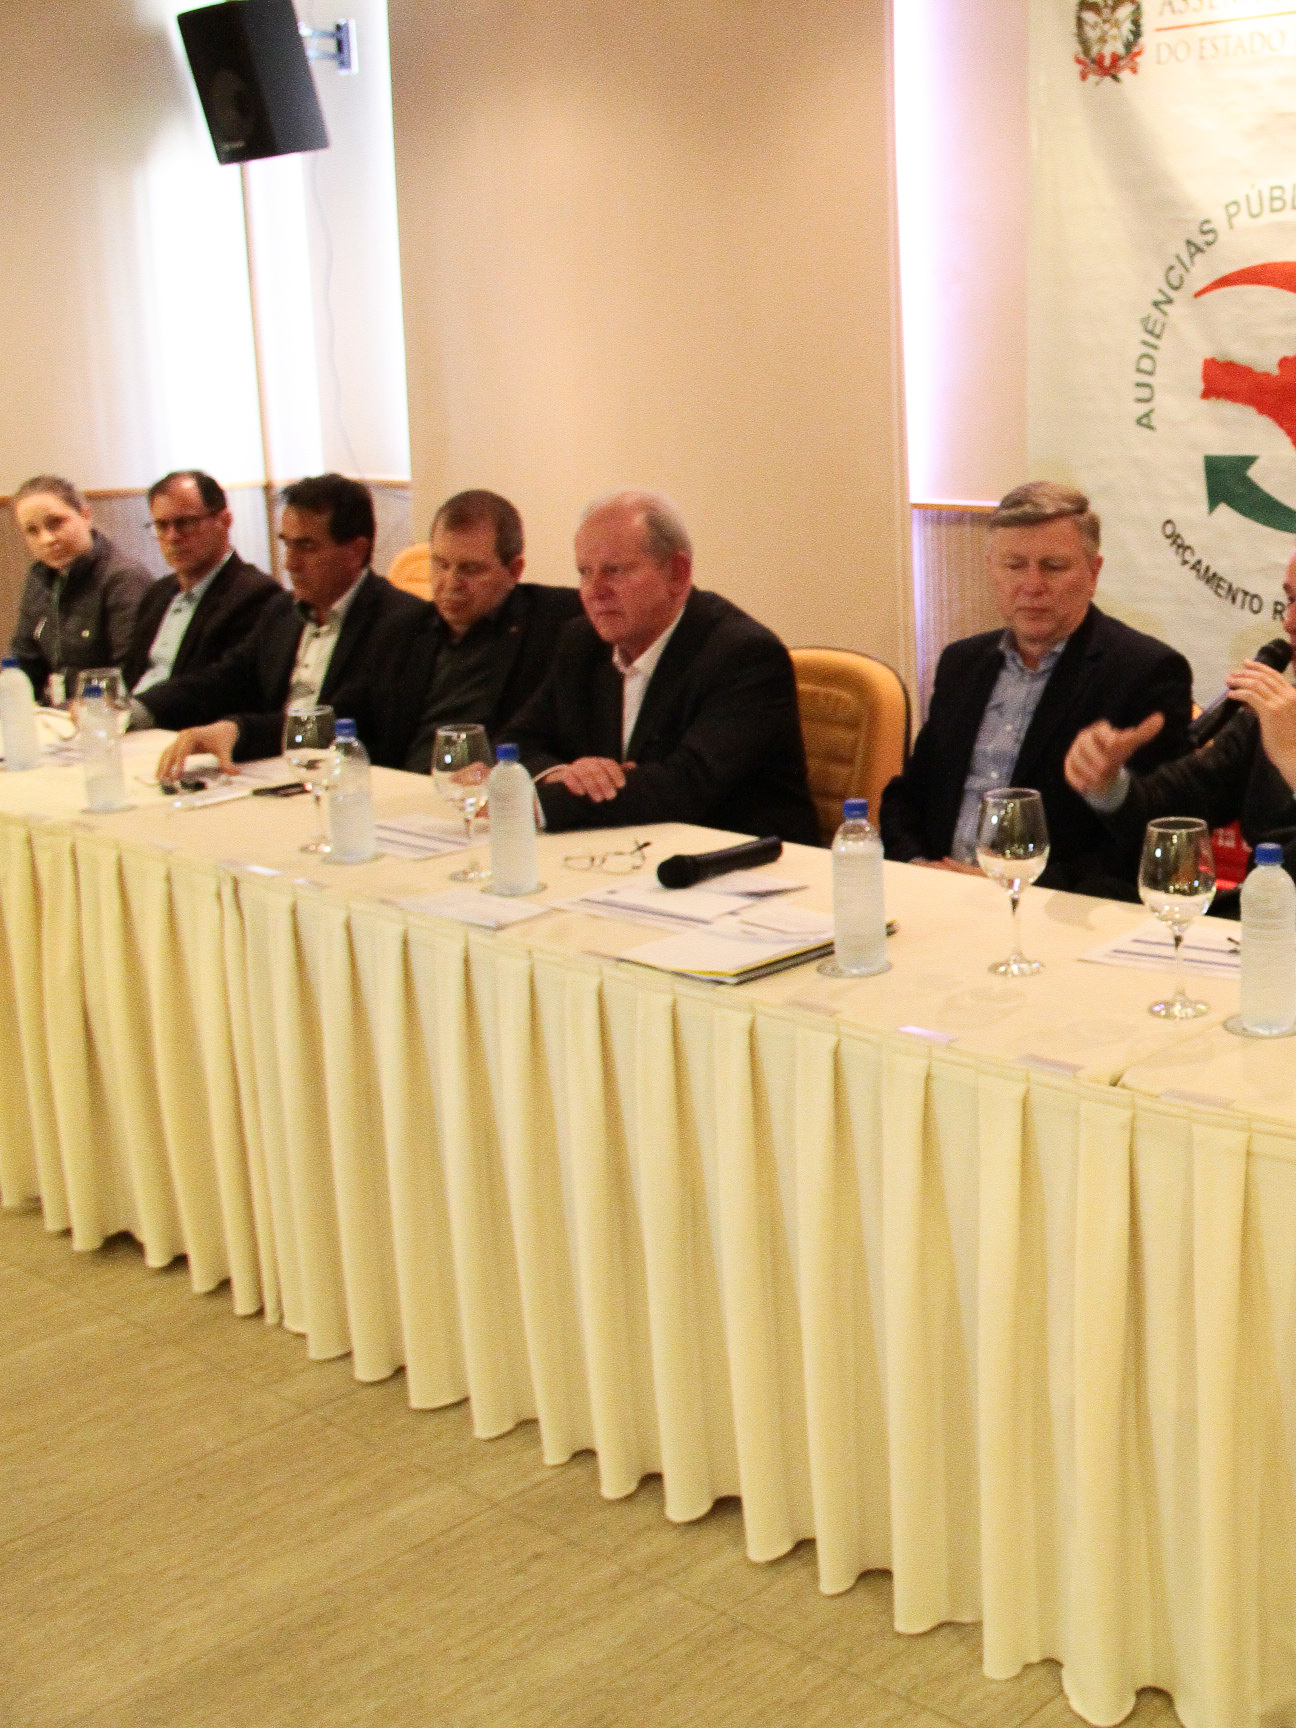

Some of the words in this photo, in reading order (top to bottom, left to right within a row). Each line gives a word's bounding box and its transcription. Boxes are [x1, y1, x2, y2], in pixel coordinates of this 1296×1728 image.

[1155, 39, 1192, 66] DO
[1199, 29, 1287, 61] ESTADO
[1134, 218, 1219, 432] AUDIÊNCIAS
[1161, 519, 1264, 615] ORÇAMENTO
